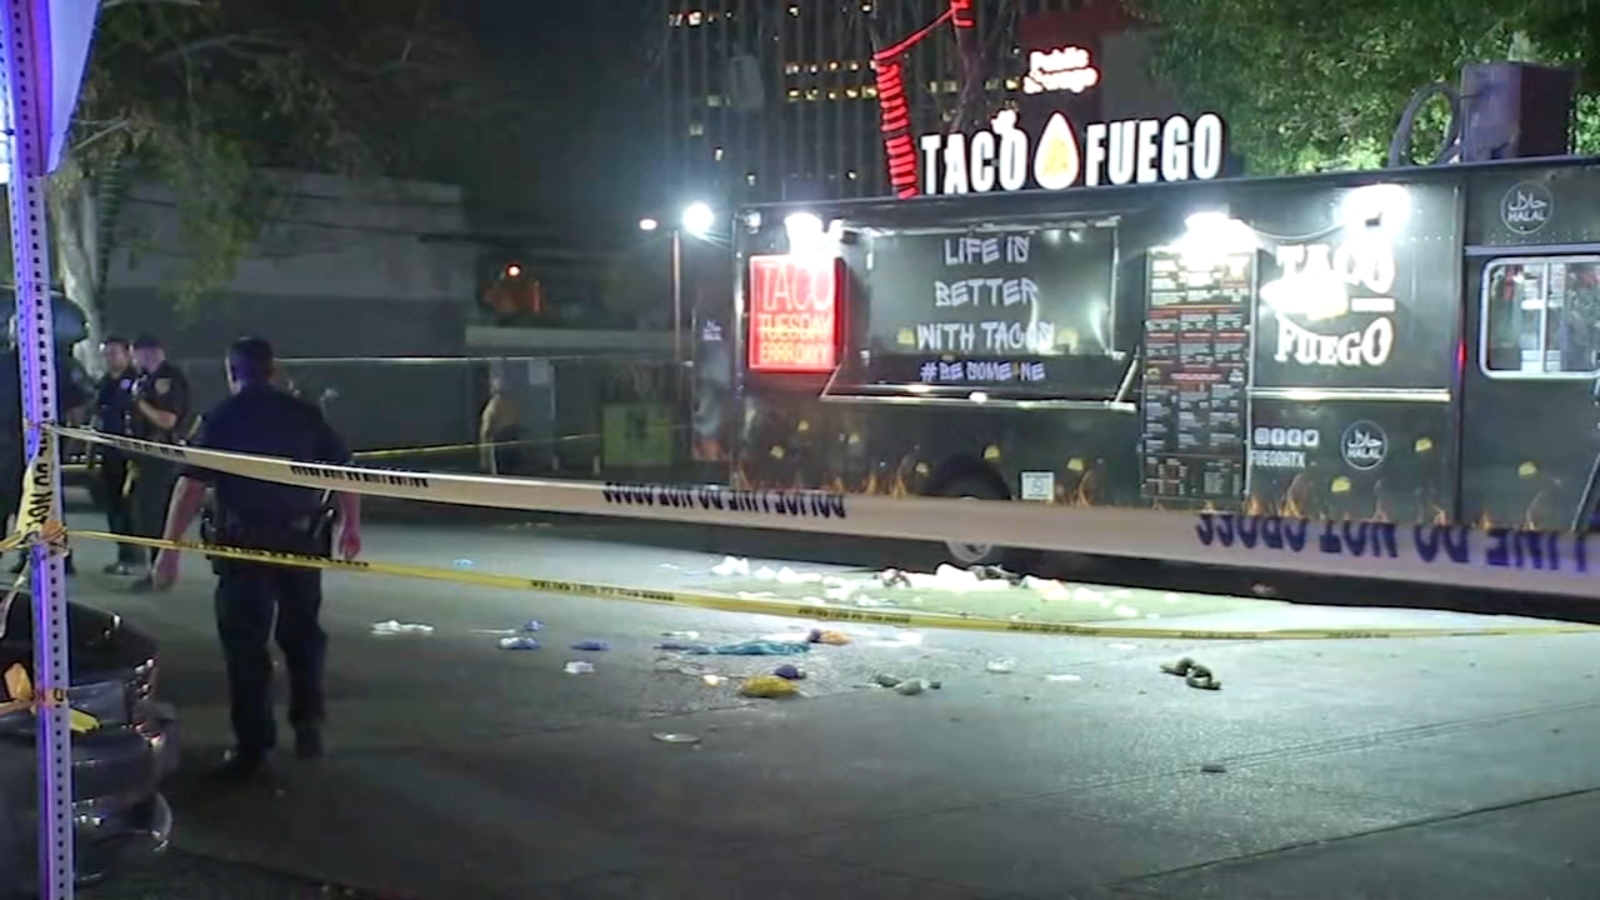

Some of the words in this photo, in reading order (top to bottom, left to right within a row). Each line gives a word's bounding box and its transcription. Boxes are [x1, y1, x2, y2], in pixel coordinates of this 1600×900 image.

[920, 128, 1028, 195] TACO
[1085, 113, 1223, 187] FUEGO
[1508, 210, 1546, 222] HALAL
[944, 237, 1001, 265] LIFE
[1006, 235, 1030, 263] IS
[1274, 230, 1396, 294] TACO
[757, 259, 834, 311] TACO
[934, 276, 1040, 307] BETTER
[758, 313, 834, 341] TUESDAY
[917, 322, 975, 351] WITH
[980, 321, 1056, 352] TACOS
[1273, 316, 1393, 367] FUEGO
[1347, 446, 1383, 459] HALAL
[1195, 513, 1308, 553] CROSS
[1319, 520, 1399, 559] NOT
